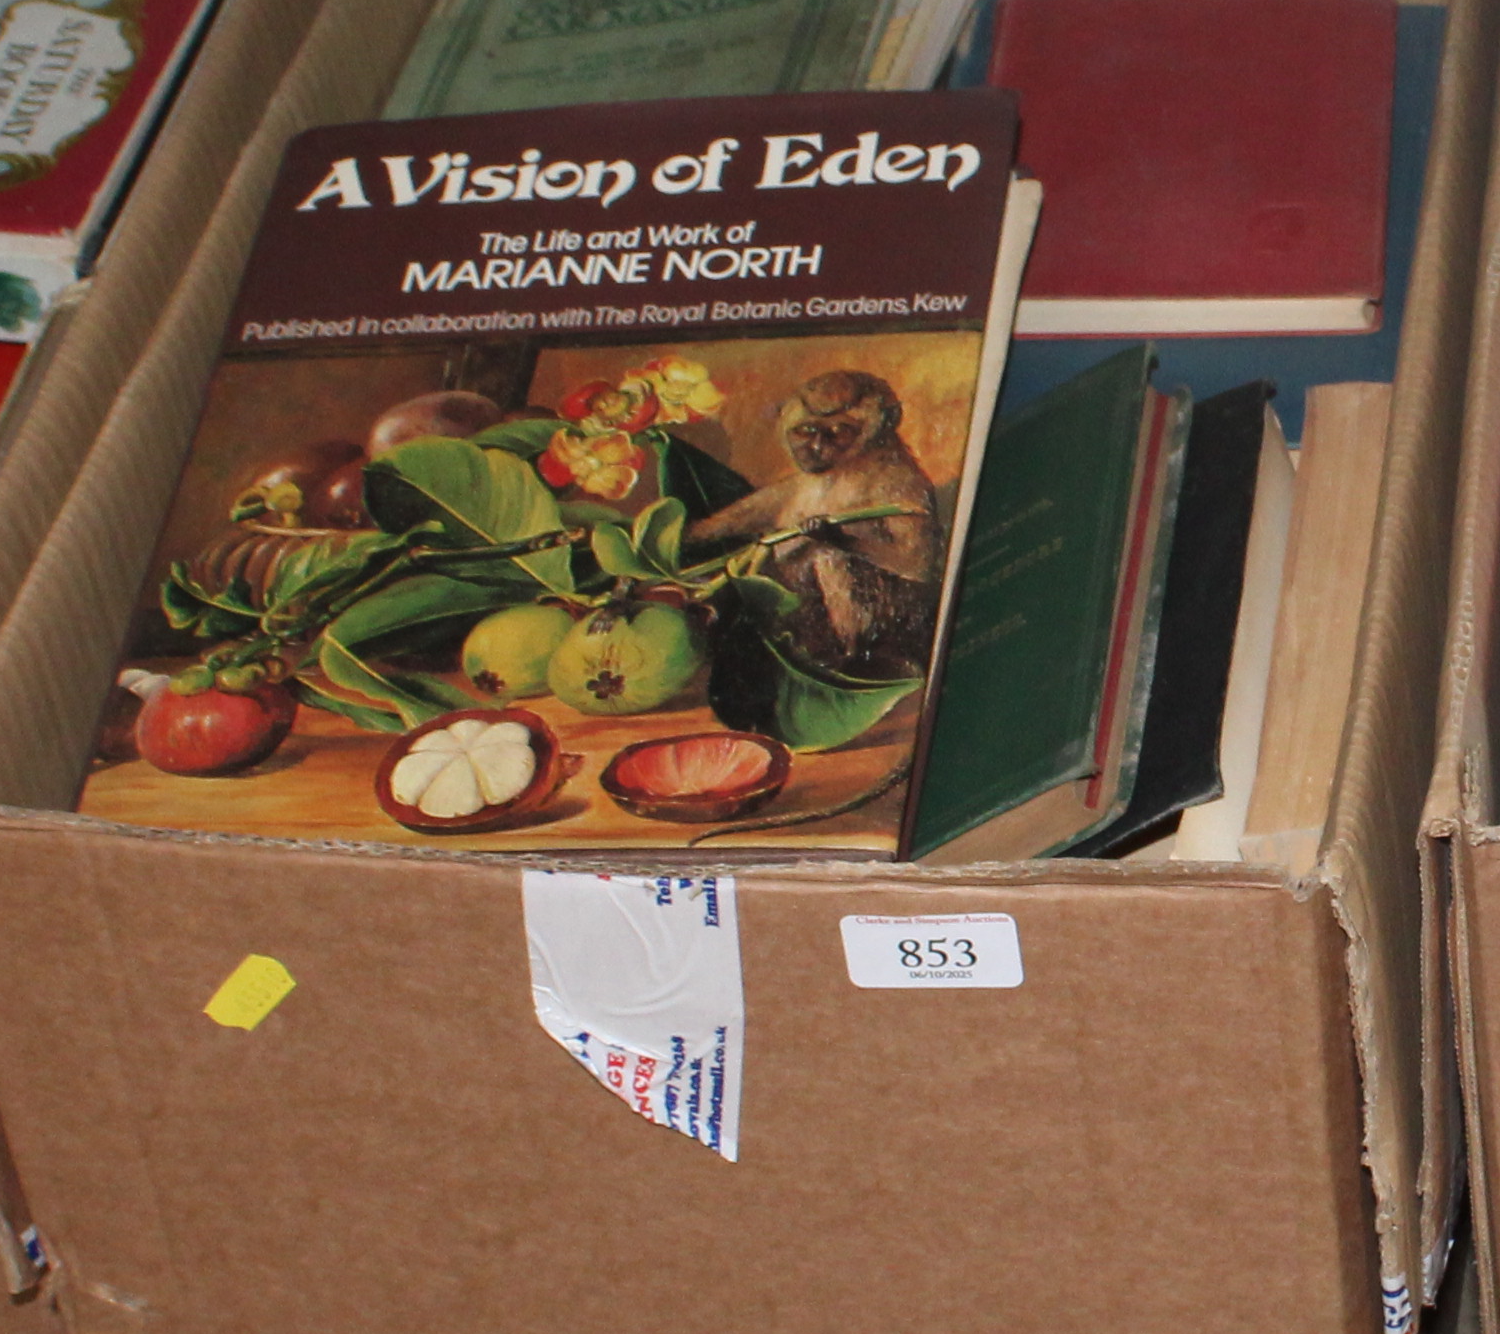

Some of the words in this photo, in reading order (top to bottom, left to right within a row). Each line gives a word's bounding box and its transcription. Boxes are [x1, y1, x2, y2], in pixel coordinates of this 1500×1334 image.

[0, 20, 94, 144] SATURDAY
[297, 158, 368, 212] A
[380, 149, 637, 208] Vision
[651, 137, 740, 195] of
[755, 132, 981, 196] Eden
[479, 230, 528, 255] The
[534, 227, 581, 253] Life
[586, 224, 640, 250] and
[648, 221, 722, 247] Work
[725, 220, 757, 244] of
[401, 253, 650, 292] MARIANNE
[662, 244, 822, 283] NORTH
[242, 318, 353, 341] Published
[359, 317, 380, 336] in
[381, 307, 535, 335] collaboration
[541, 305, 591, 329] with
[592, 303, 636, 327] The
[640, 300, 706, 327] Royal
[712, 297, 800, 323] Botanic
[805, 293, 910, 320] Gardens,
[912, 291, 967, 315] Kew
[897, 937, 978, 969] 853
[632, 1057, 658, 1123] NCES
